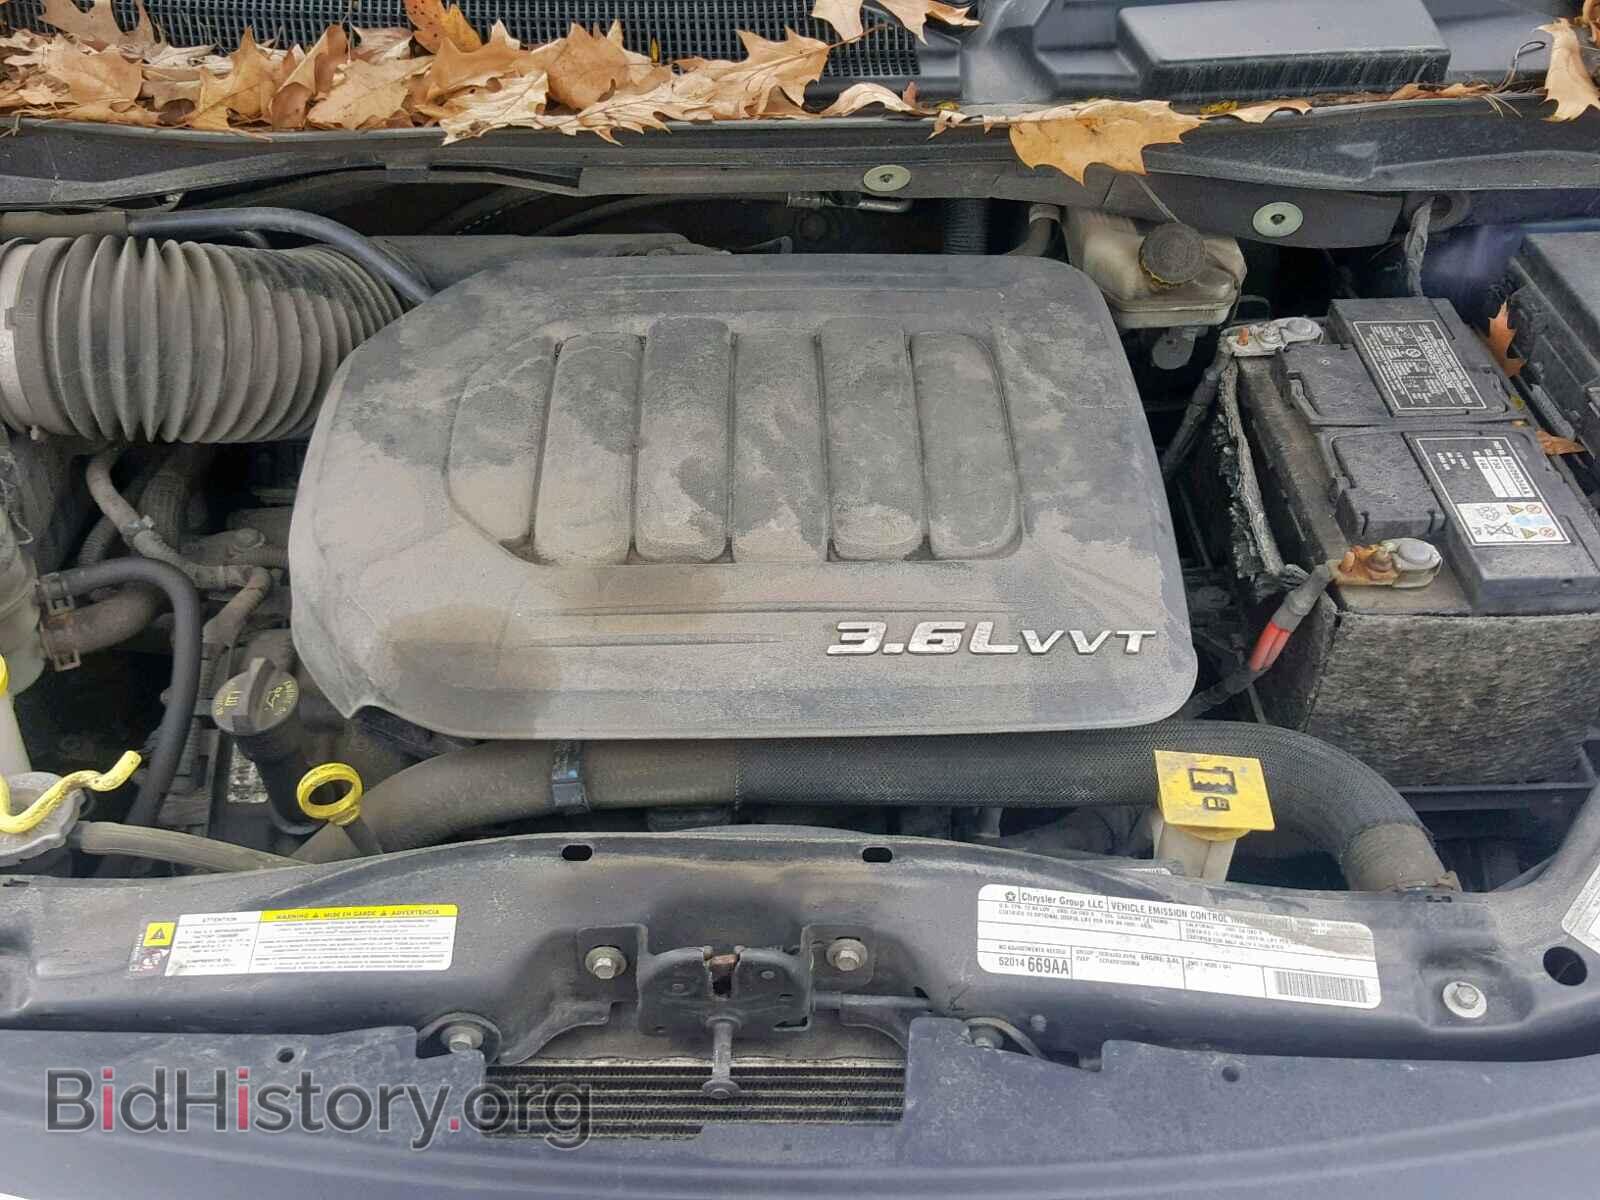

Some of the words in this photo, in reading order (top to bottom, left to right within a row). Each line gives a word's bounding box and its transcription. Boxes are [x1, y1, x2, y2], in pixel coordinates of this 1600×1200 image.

[1021, 892, 1056, 905] Chrysler
[1059, 896, 1085, 909] Group
[1087, 898, 1104, 909] LLC
[1111, 902, 1146, 914] VEHICLE
[1148, 905, 1188, 918] EMISSION
[1190, 911, 1228, 923] CONTROL
[998, 956, 1025, 967] 52014
[1027, 956, 1070, 975] 669AA
